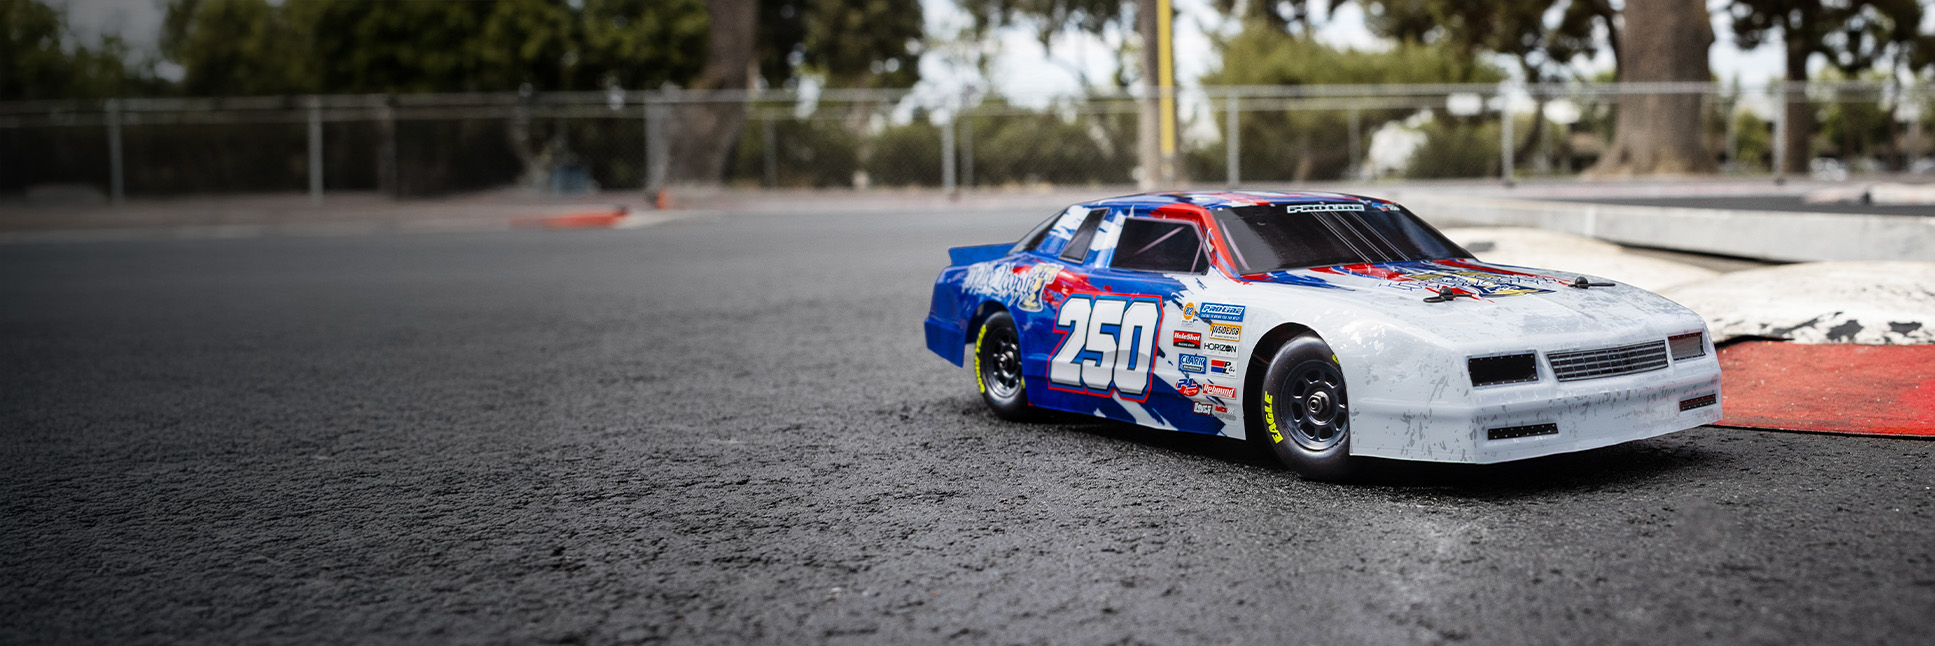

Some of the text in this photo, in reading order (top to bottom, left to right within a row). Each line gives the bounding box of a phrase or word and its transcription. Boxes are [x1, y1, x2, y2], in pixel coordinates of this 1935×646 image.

[1184, 306, 1194, 316] 82
[1049, 296, 1160, 396] 250
[1203, 342, 1237, 353] HORIZON
[1181, 355, 1206, 367] CLARK
[1203, 384, 1235, 398] Rebound
[1264, 391, 1284, 444] EAGLE
